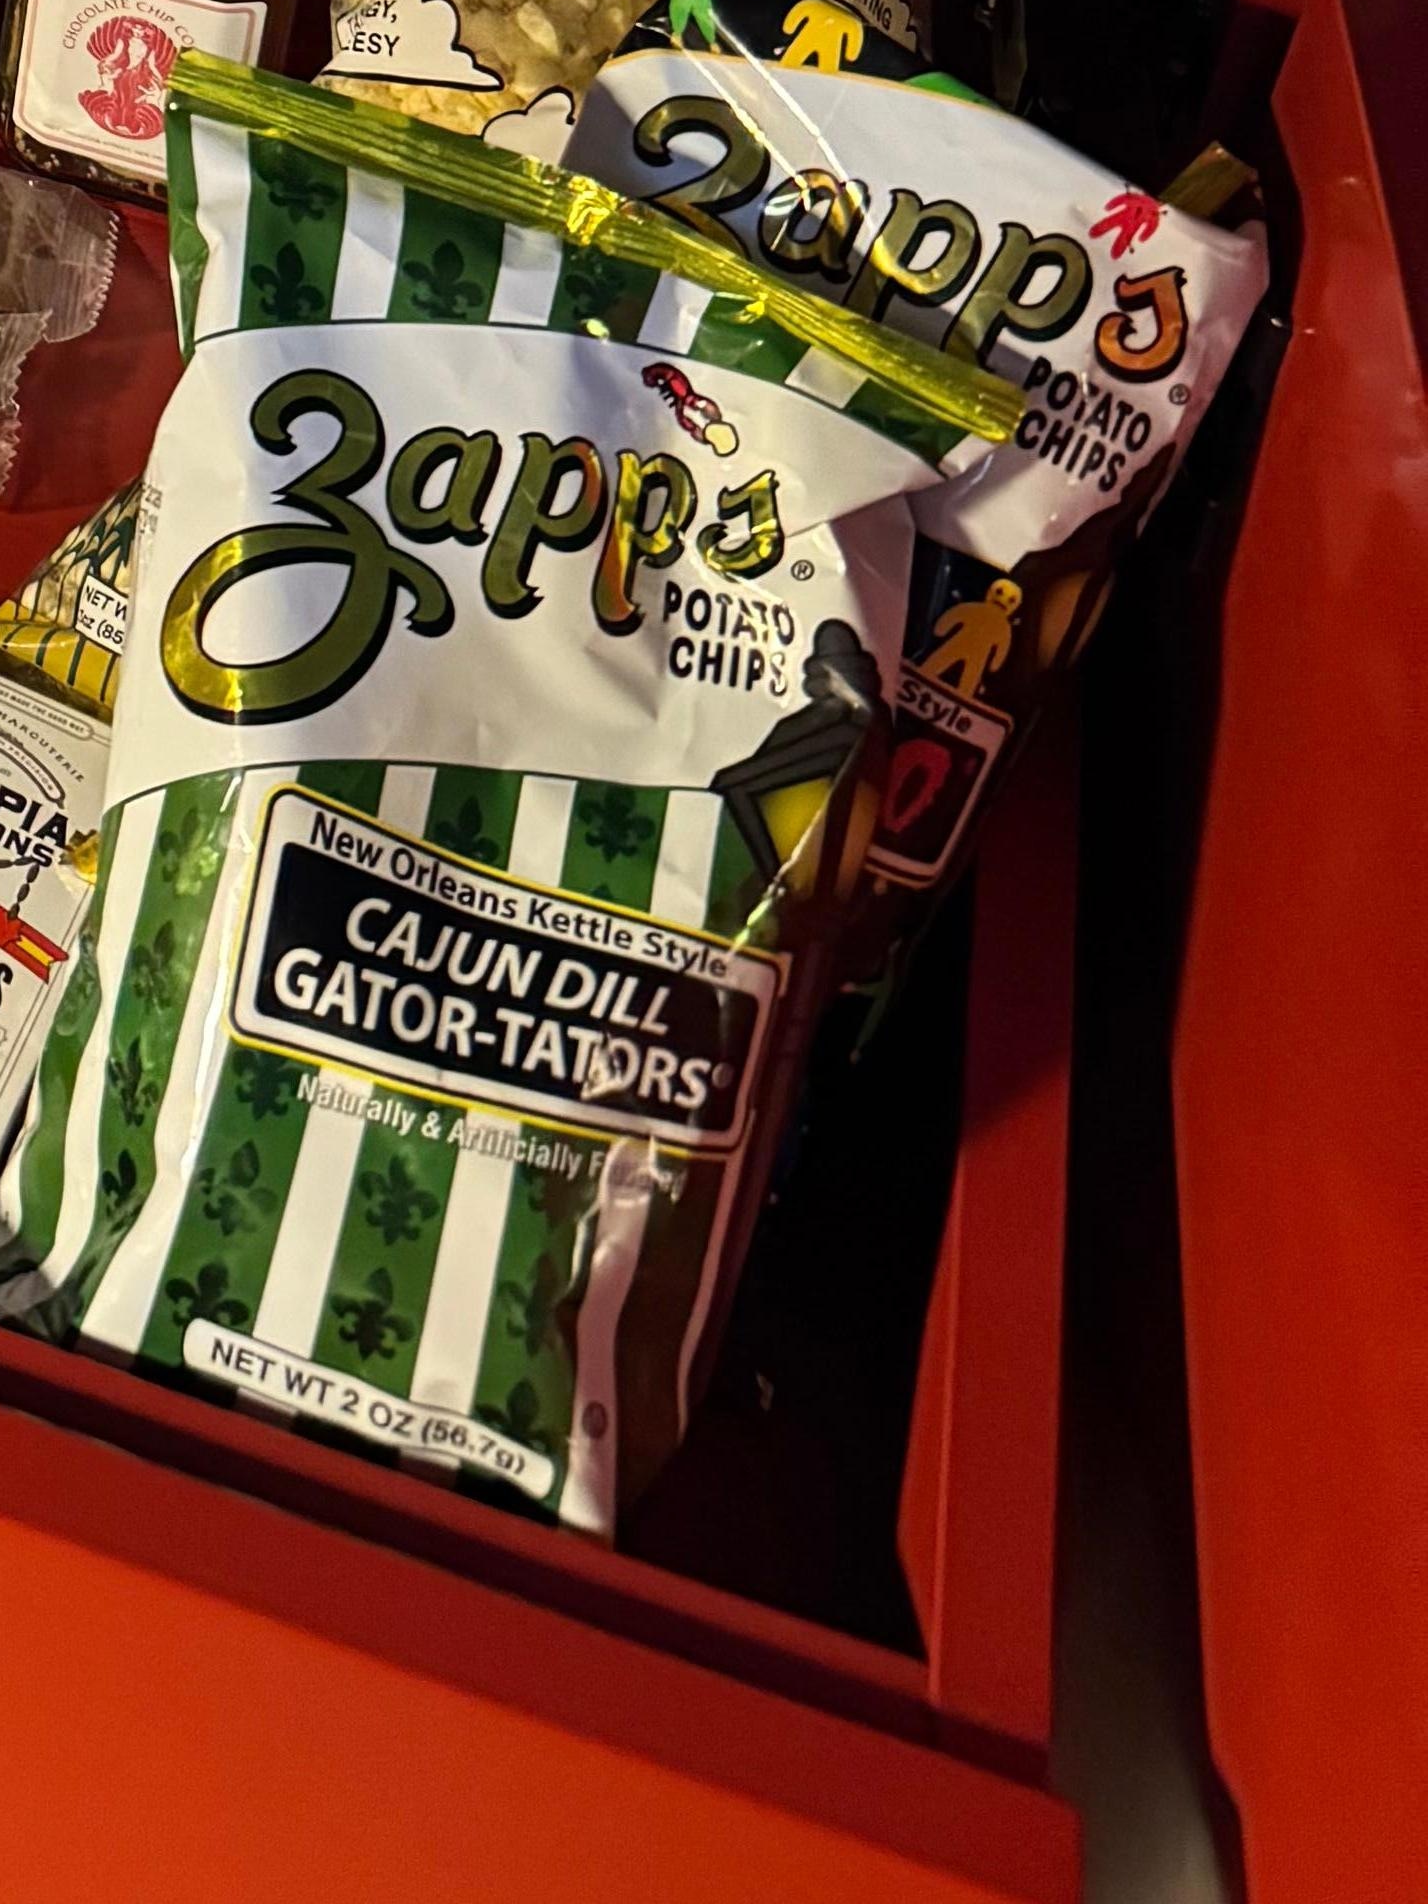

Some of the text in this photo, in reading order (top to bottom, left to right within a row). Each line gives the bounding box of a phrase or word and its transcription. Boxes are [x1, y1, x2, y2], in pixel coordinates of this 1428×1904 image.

[135, 0, 175, 26] CHIP
[1025, 356, 1154, 451] POTATO
[1013, 409, 1131, 495] CHIPS
[661, 581, 797, 649] POTATO
[666, 634, 788, 698] CHIPS
[894, 676, 975, 738] Style
[308, 809, 731, 981] New Orleans Kettle Style
[344, 897, 673, 1038] CAJUN DILL
[295, 1071, 419, 1136] Naturally
[209, 1336, 527, 1478] NET WT 2 OZ (56.7g)
